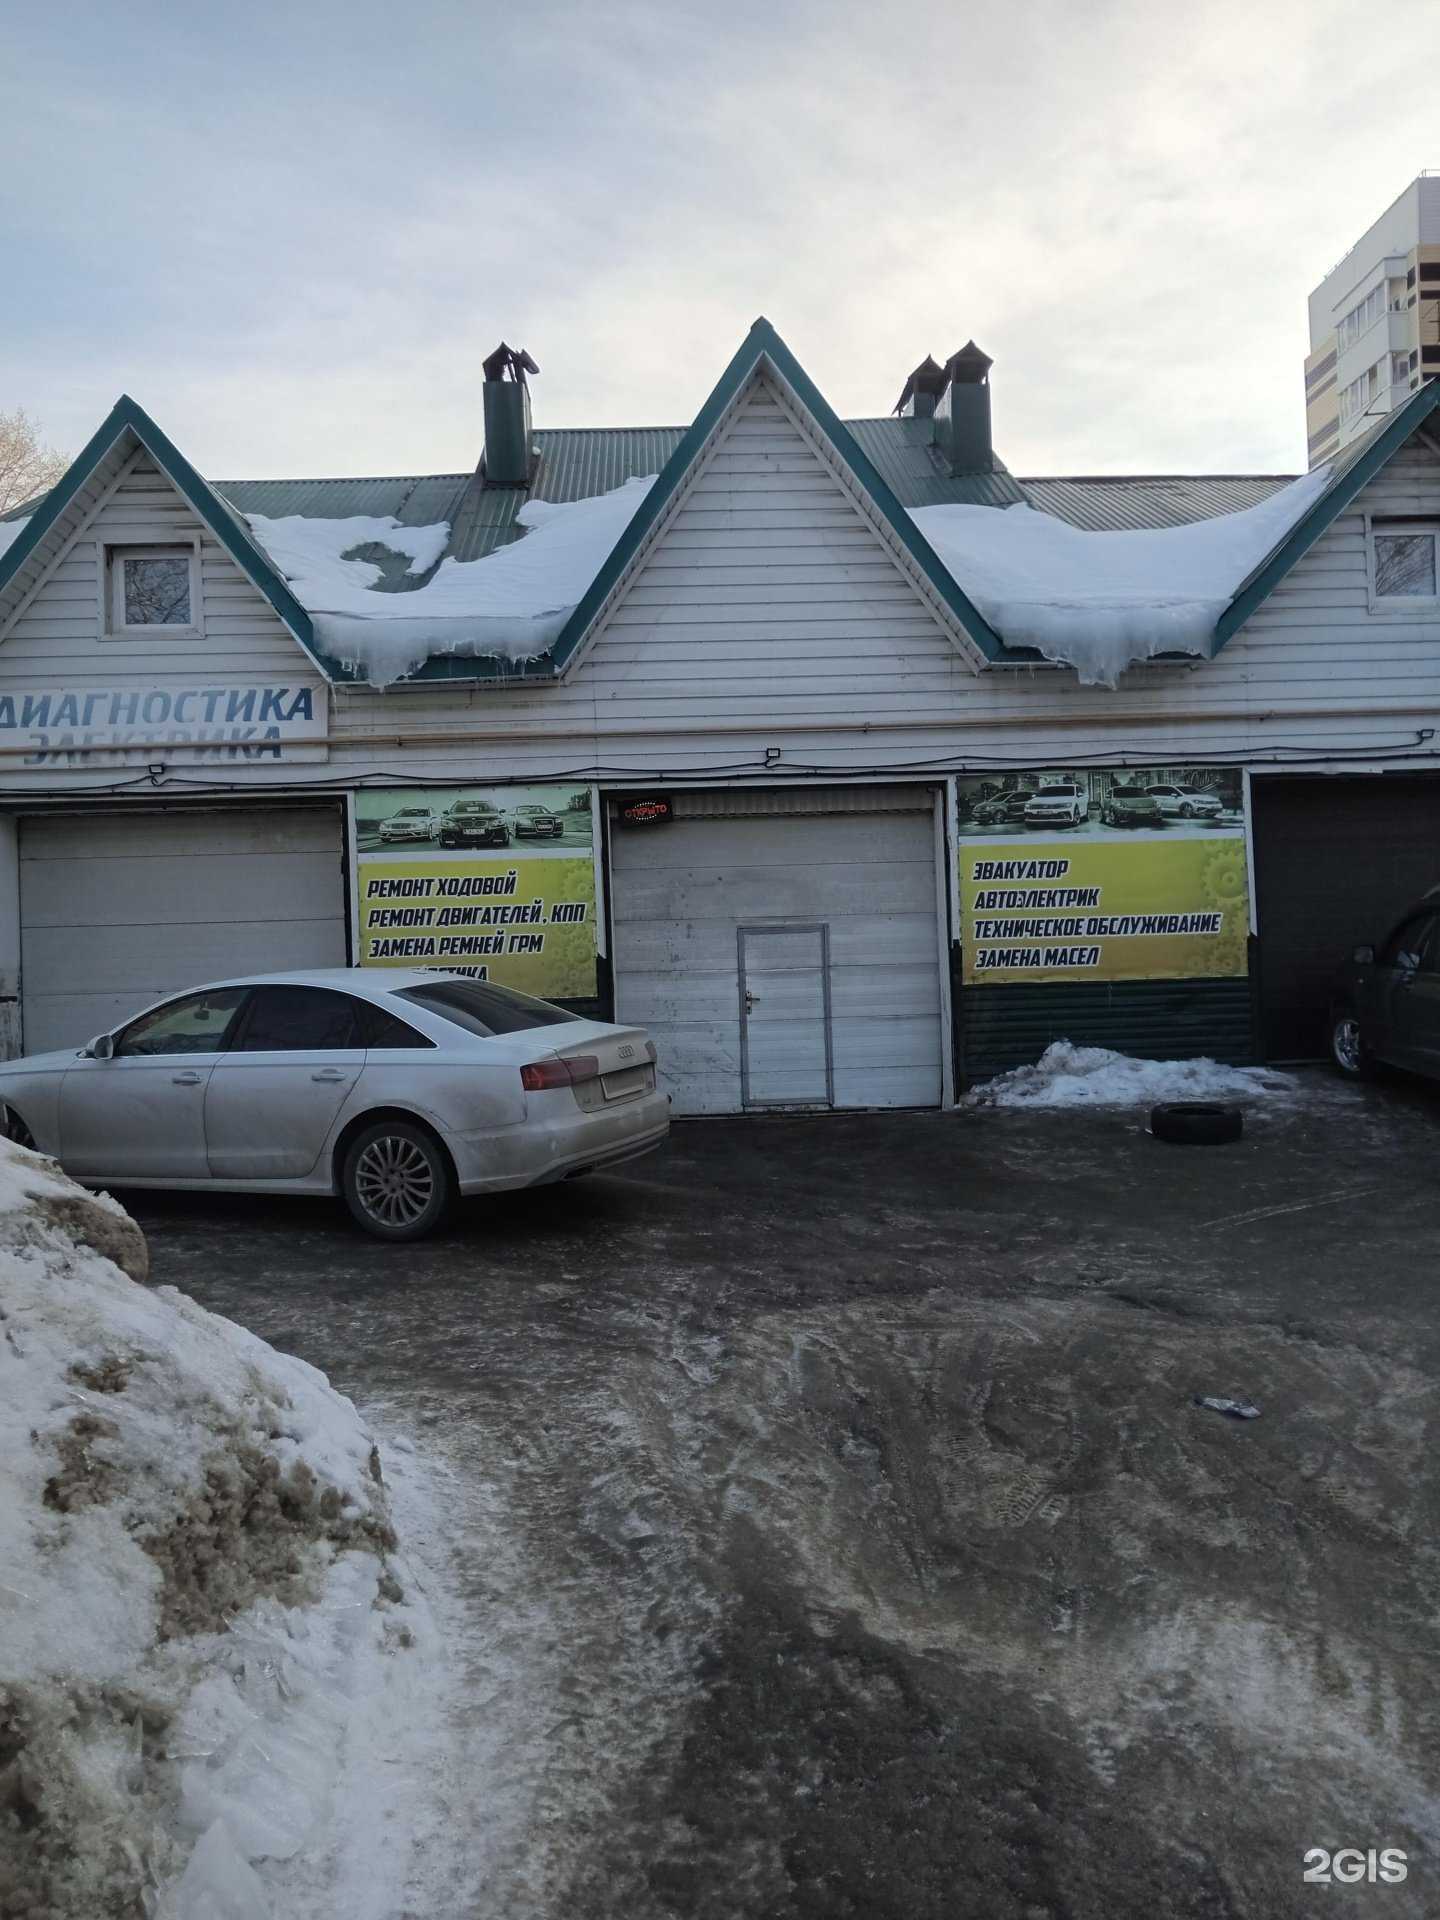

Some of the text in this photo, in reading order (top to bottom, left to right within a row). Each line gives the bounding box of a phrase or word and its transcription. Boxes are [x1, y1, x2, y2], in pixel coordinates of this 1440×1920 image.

[0, 688, 313, 729] ДИАГНОСТИКА
[973, 860, 1069, 880] ЭВАКУАТОР
[367, 871, 516, 898] РЕМОНТ ХОДОВОЙ
[974, 888, 1100, 909] АВТОЭЛЕКТРИК
[368, 908, 436, 927] РЕМОНТ
[551, 904, 585, 922] КПП
[975, 913, 1221, 938] ТЕХНИЧЕСКОЕ ОБСЛУЖИВАНИЕ
[369, 931, 543, 957] ЗАМЕНА РЕМНЕЙ ГРМ
[975, 947, 1100, 968] ЗАМЕНА МАСЕЛ
